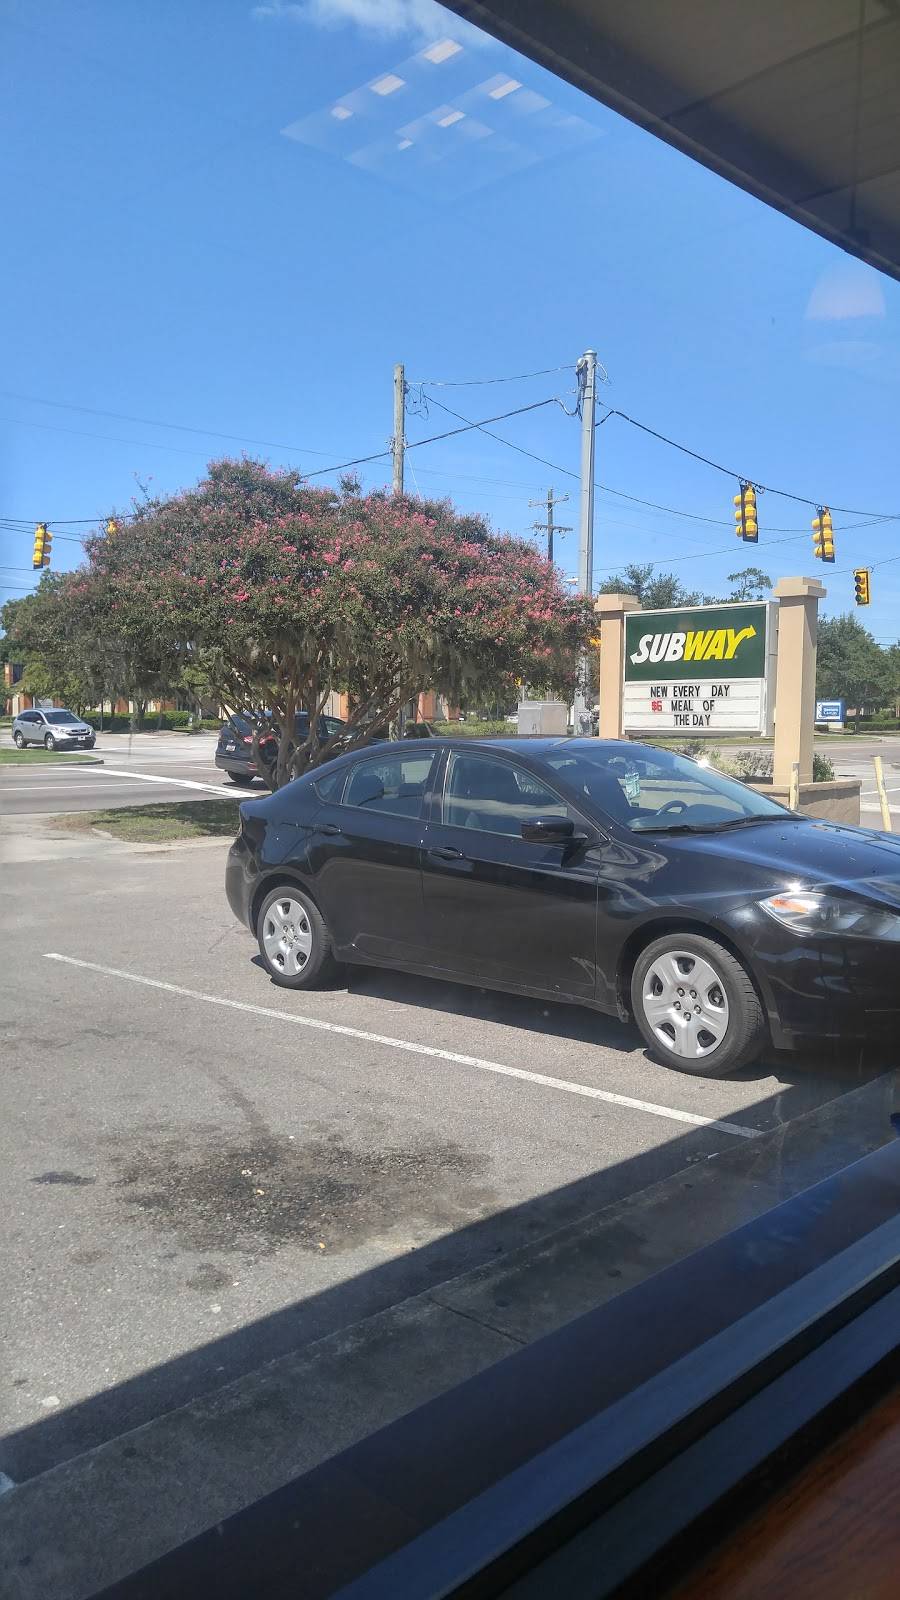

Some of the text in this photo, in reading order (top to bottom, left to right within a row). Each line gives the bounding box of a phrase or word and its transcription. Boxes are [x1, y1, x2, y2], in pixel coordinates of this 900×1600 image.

[630, 625, 756, 665] SUBWAY
[650, 684, 730, 698] NEW EVERY DAY
[651, 699, 715, 712] $6 MEAL OF
[674, 714, 711, 726] THE DAY
